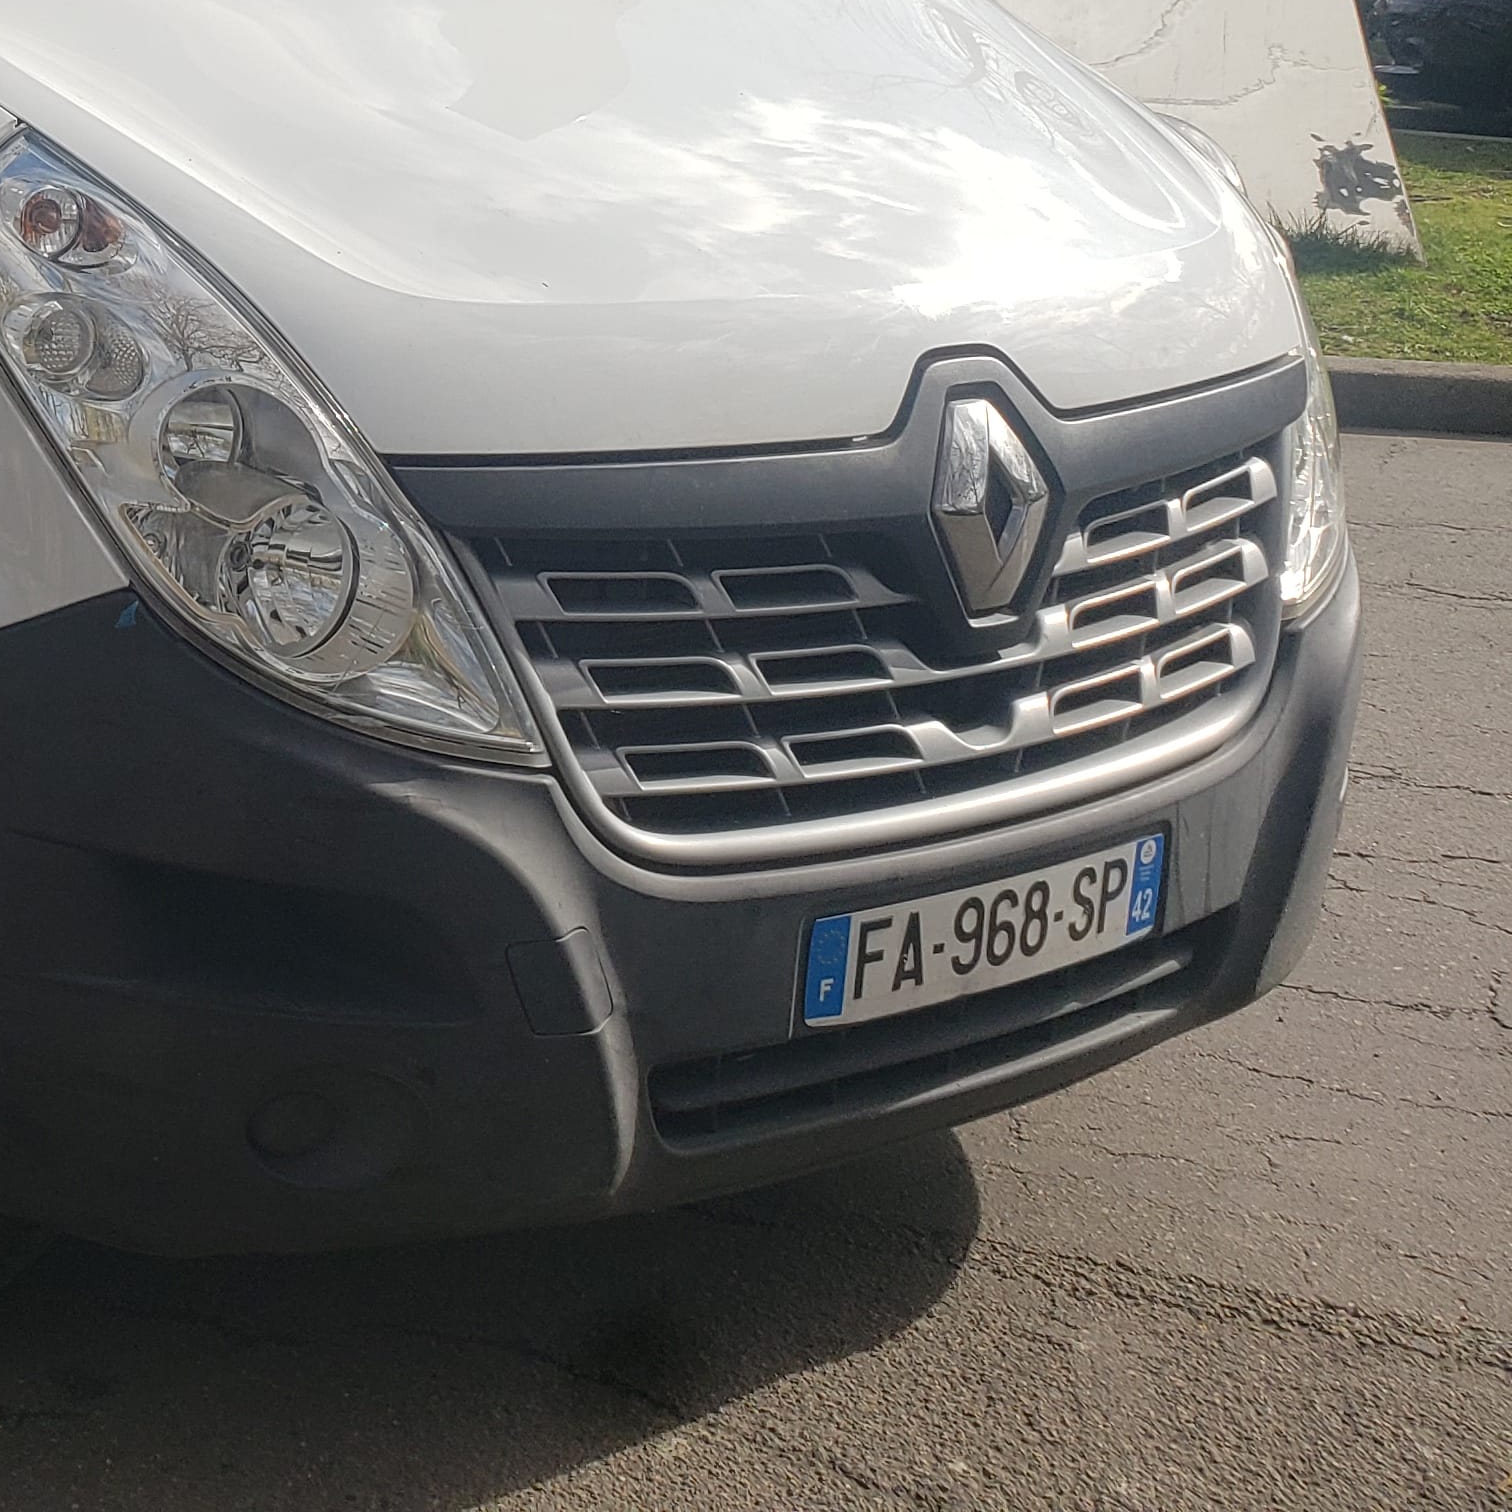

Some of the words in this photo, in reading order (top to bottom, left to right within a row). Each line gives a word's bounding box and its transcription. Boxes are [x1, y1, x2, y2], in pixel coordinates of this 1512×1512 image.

[1131, 888, 1154, 923] 42
[852, 858, 1128, 1000] FA-968-SP
[819, 978, 834, 1002] F
